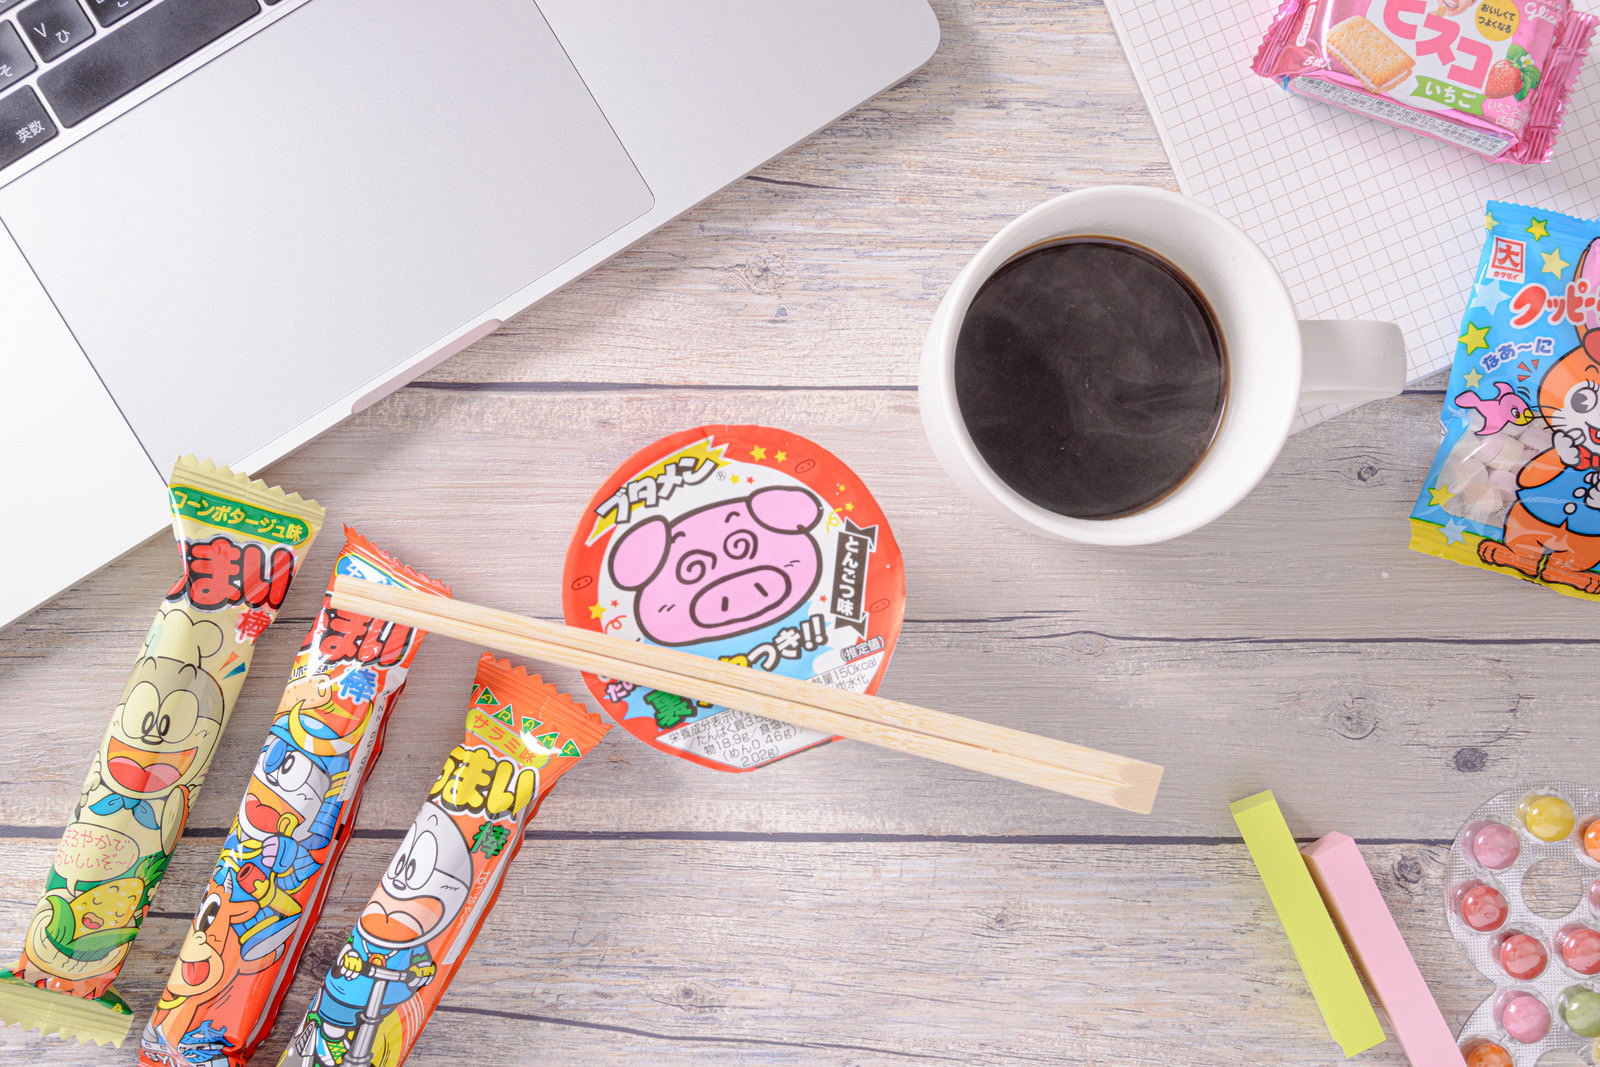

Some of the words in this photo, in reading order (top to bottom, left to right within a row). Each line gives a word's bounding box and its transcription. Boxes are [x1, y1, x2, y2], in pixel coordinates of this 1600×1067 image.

[1478, 16, 1512, 34] つよくなる
[1480, 3, 1516, 21] おいしくて
[1524, 2, 1558, 25] Glic
[33, 22, 47, 38] V
[55, 29, 71, 44] ひ
[1425, 81, 1477, 109] いちご
[16, 119, 46, 144] 英数
[1496, 242, 1521, 269] 大
[1510, 279, 1600, 328] クッピー
[594, 456, 720, 525] ブタメン
[171, 490, 303, 542] コーンポタージュ味
[836, 535, 860, 617] とんこつ味
[236, 608, 273, 646] 棒
[338, 667, 378, 704] 棒
[473, 713, 537, 764] サラミ味
